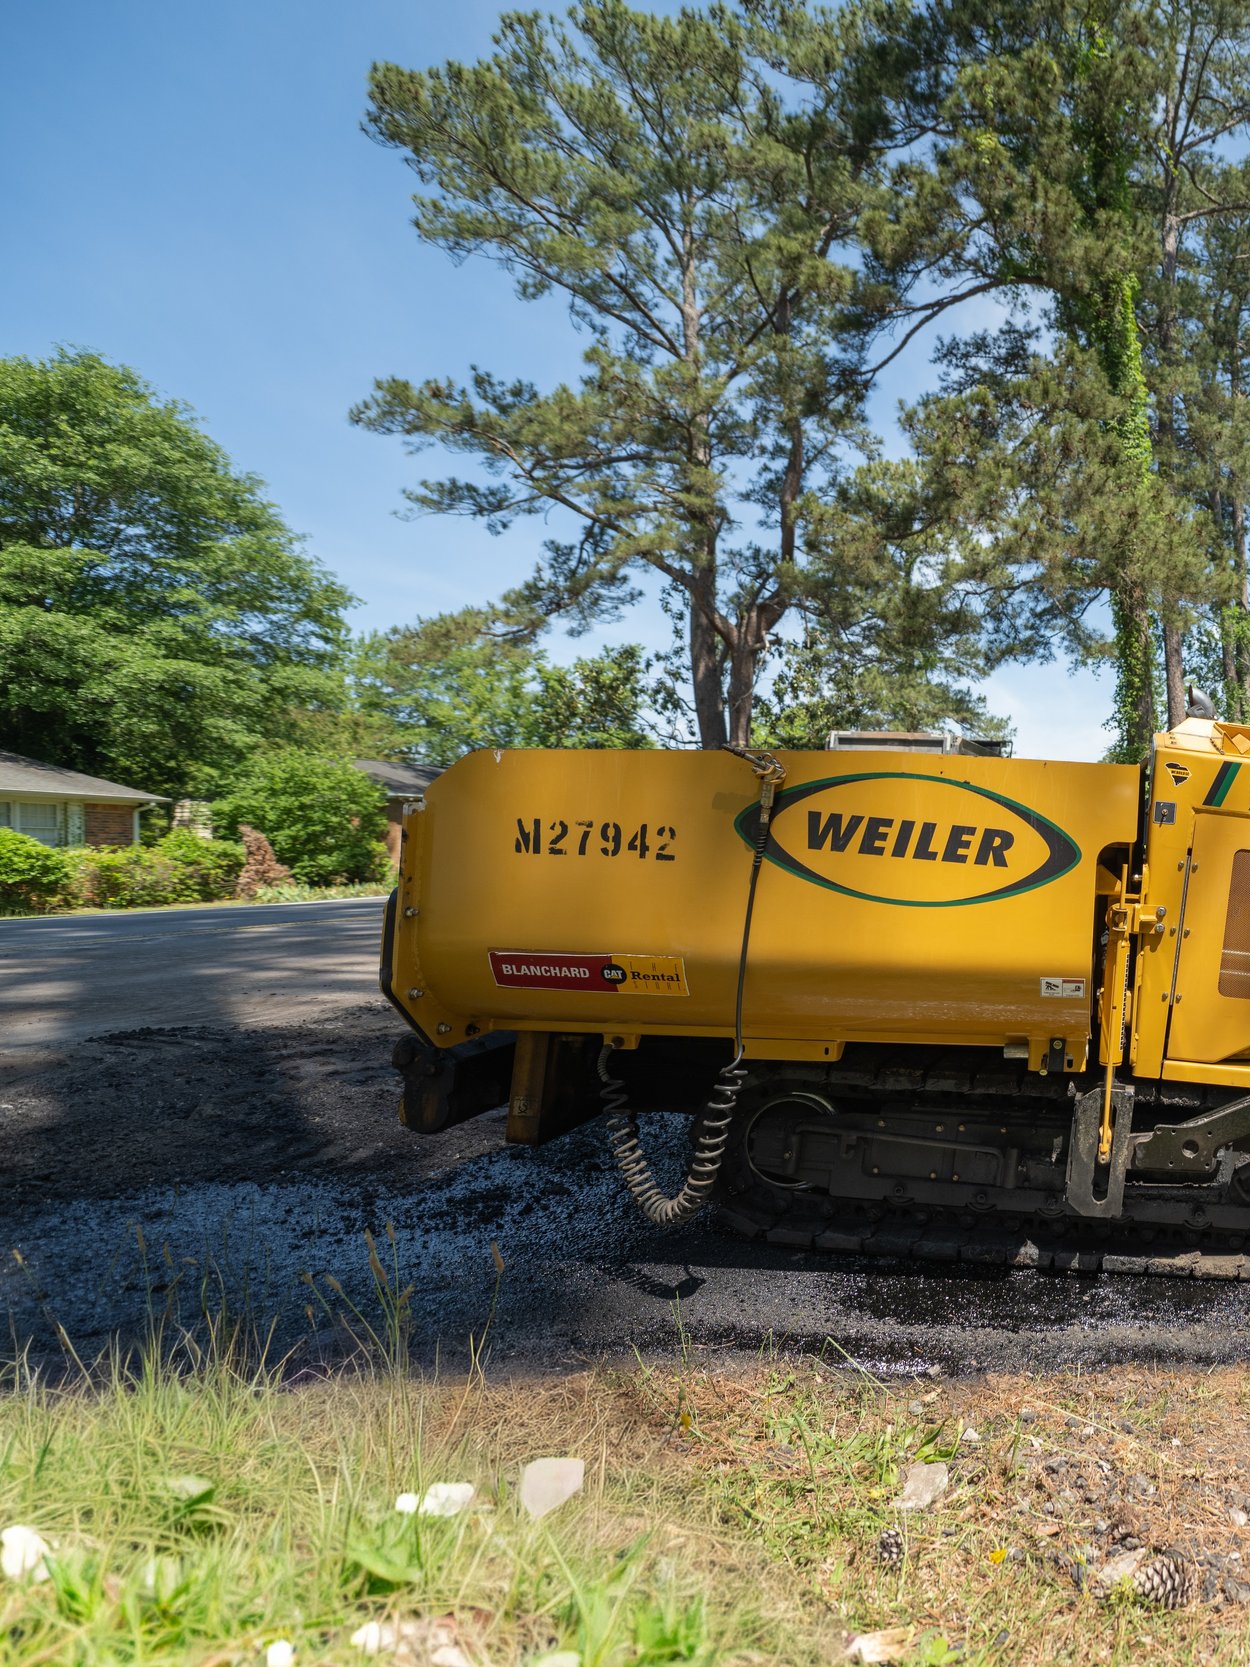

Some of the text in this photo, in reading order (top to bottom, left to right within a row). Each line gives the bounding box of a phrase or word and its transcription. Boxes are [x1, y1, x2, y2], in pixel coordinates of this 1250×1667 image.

[515, 818, 677, 861] M27942
[808, 830, 1014, 868] WEILER
[502, 964, 590, 978] BLANCHARD
[604, 969, 624, 980] CAT
[630, 971, 681, 982] Rental
